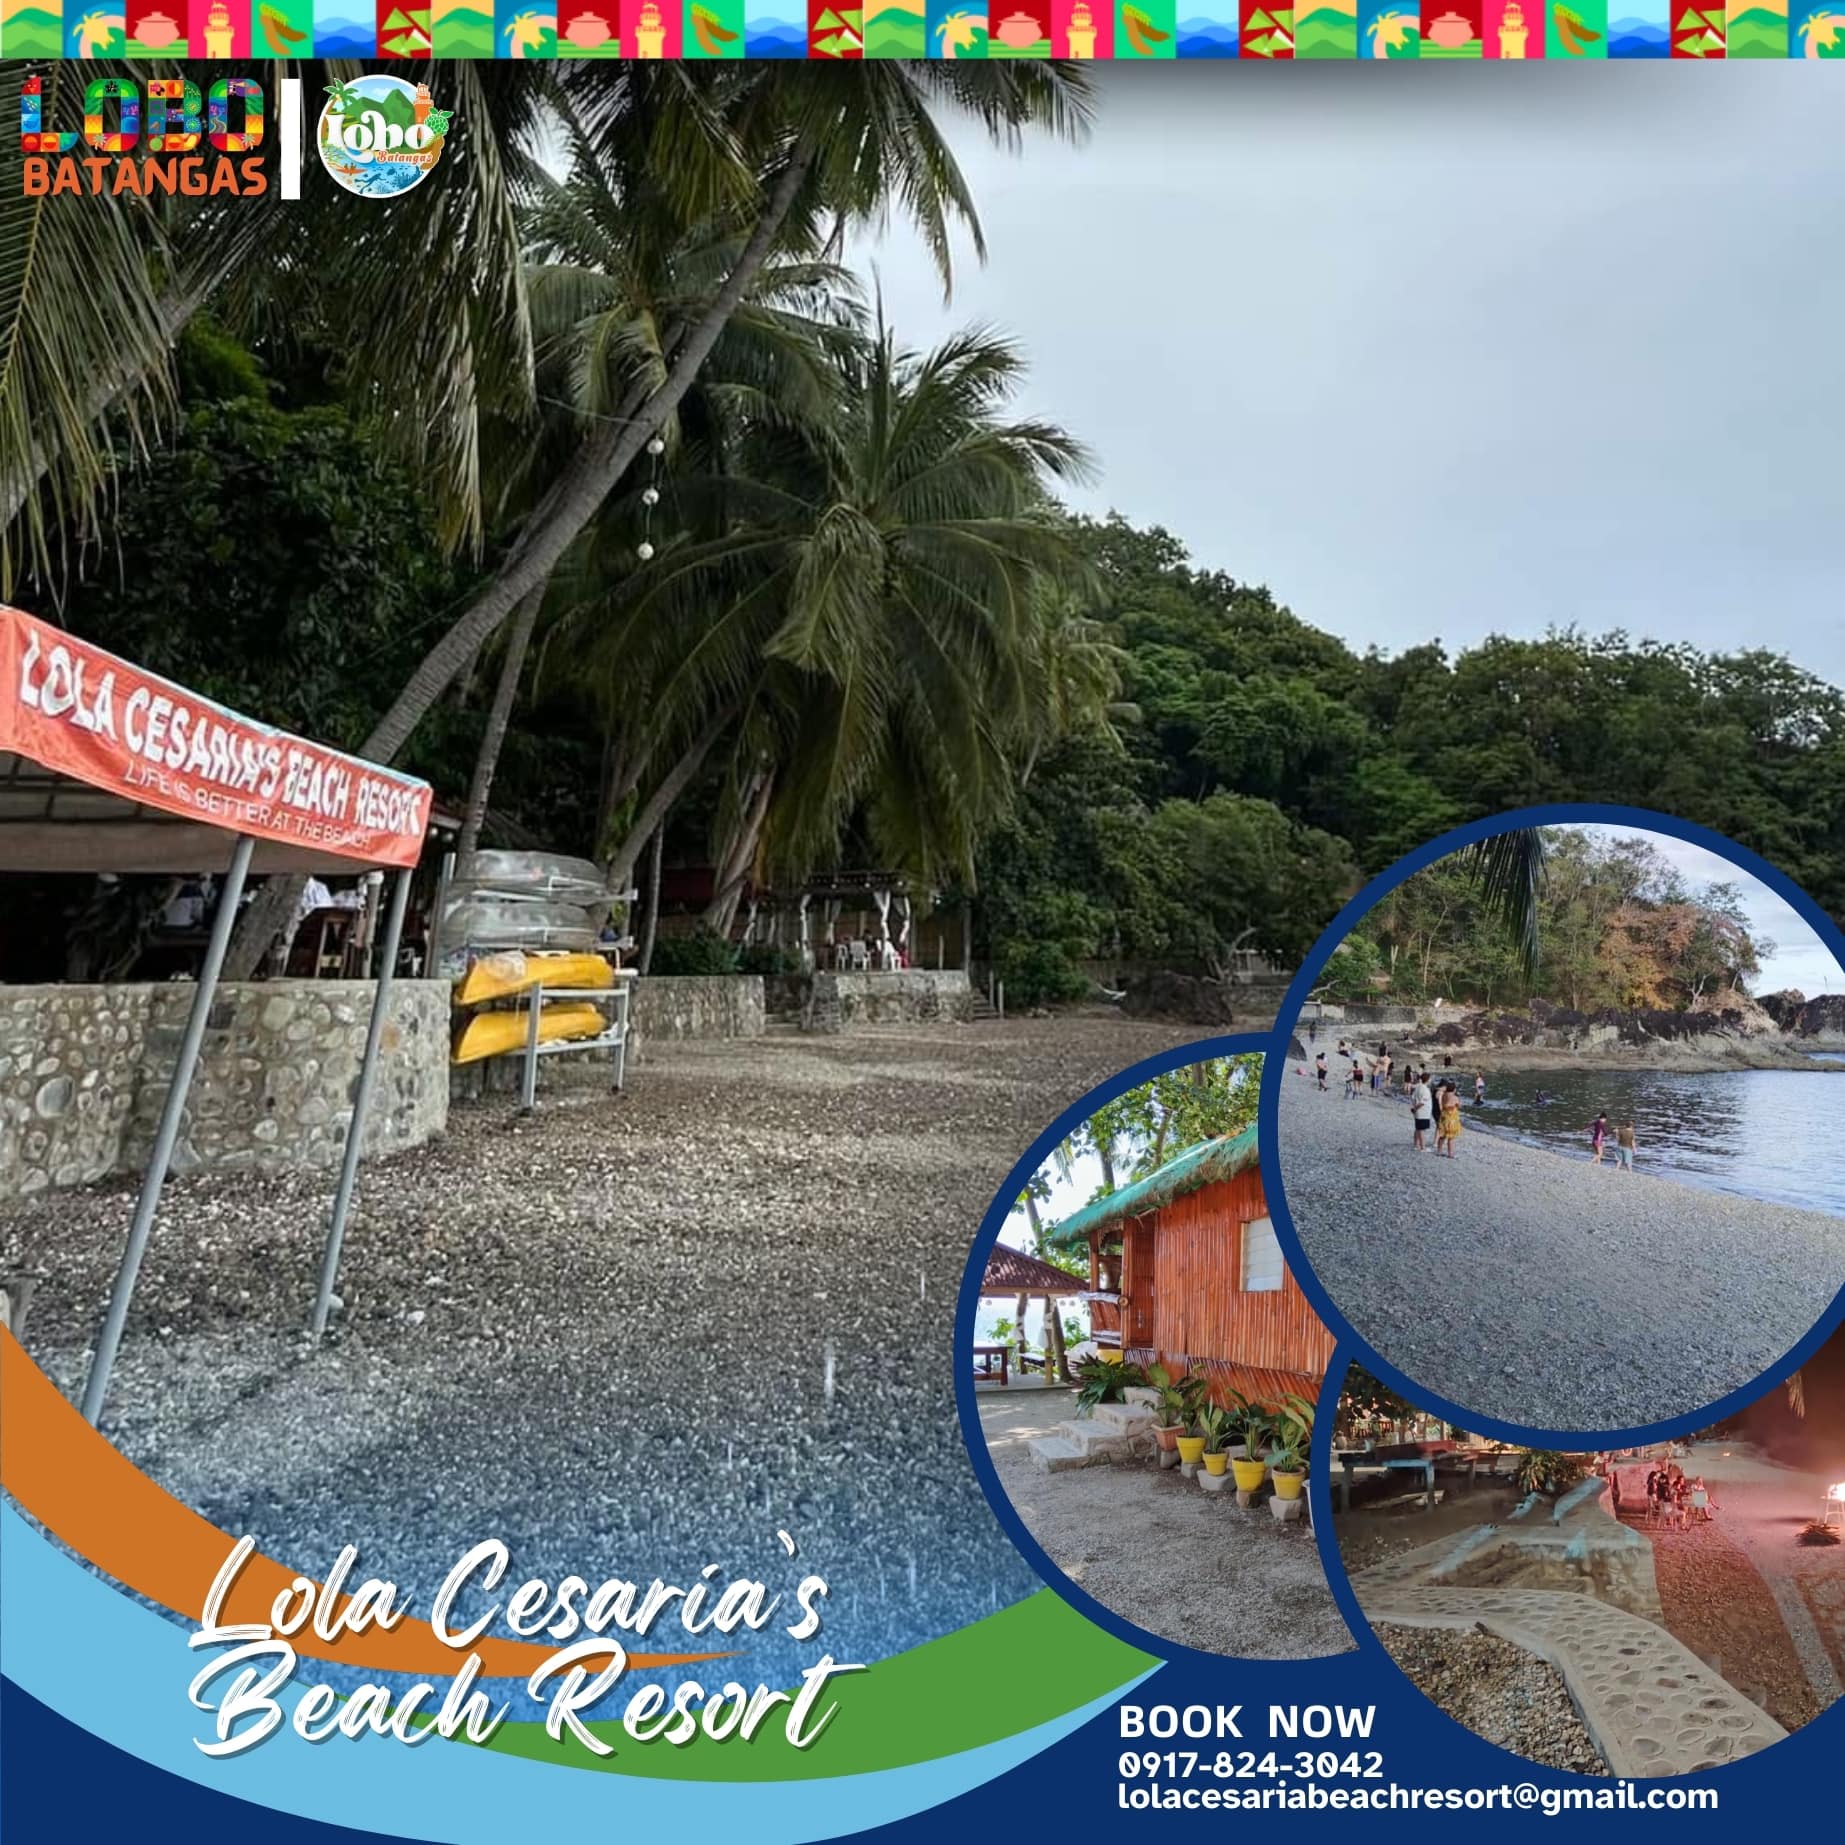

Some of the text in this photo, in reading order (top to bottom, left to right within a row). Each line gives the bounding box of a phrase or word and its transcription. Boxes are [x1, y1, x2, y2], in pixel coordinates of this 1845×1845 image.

[21, 628, 422, 836] LOLA CESARIA'S BEACH RESORT
[124, 760, 372, 848] LIFE IS BETTER AT THE BEACH
